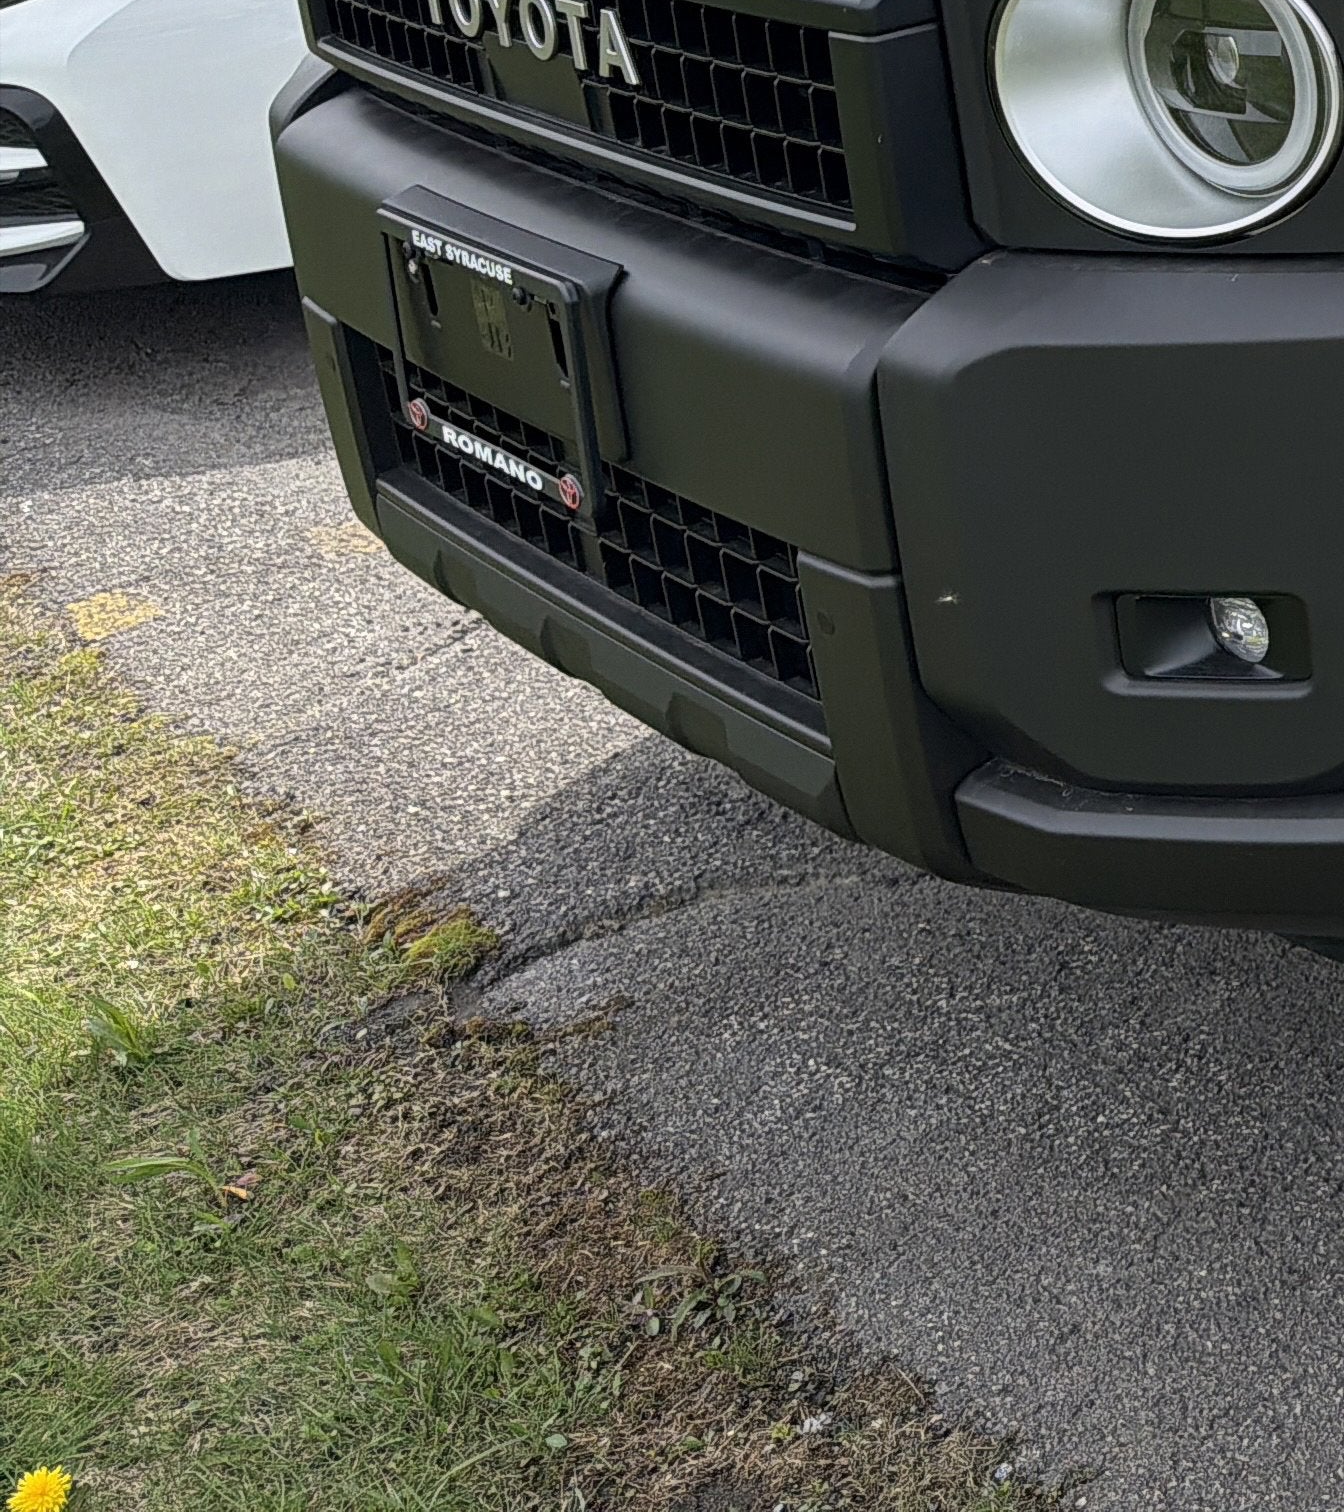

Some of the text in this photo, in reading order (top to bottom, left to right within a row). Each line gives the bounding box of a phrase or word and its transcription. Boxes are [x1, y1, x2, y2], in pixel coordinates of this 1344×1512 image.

[411, 229, 513, 286] EAST SYRACUSE
[442, 425, 543, 491] ROMANO
